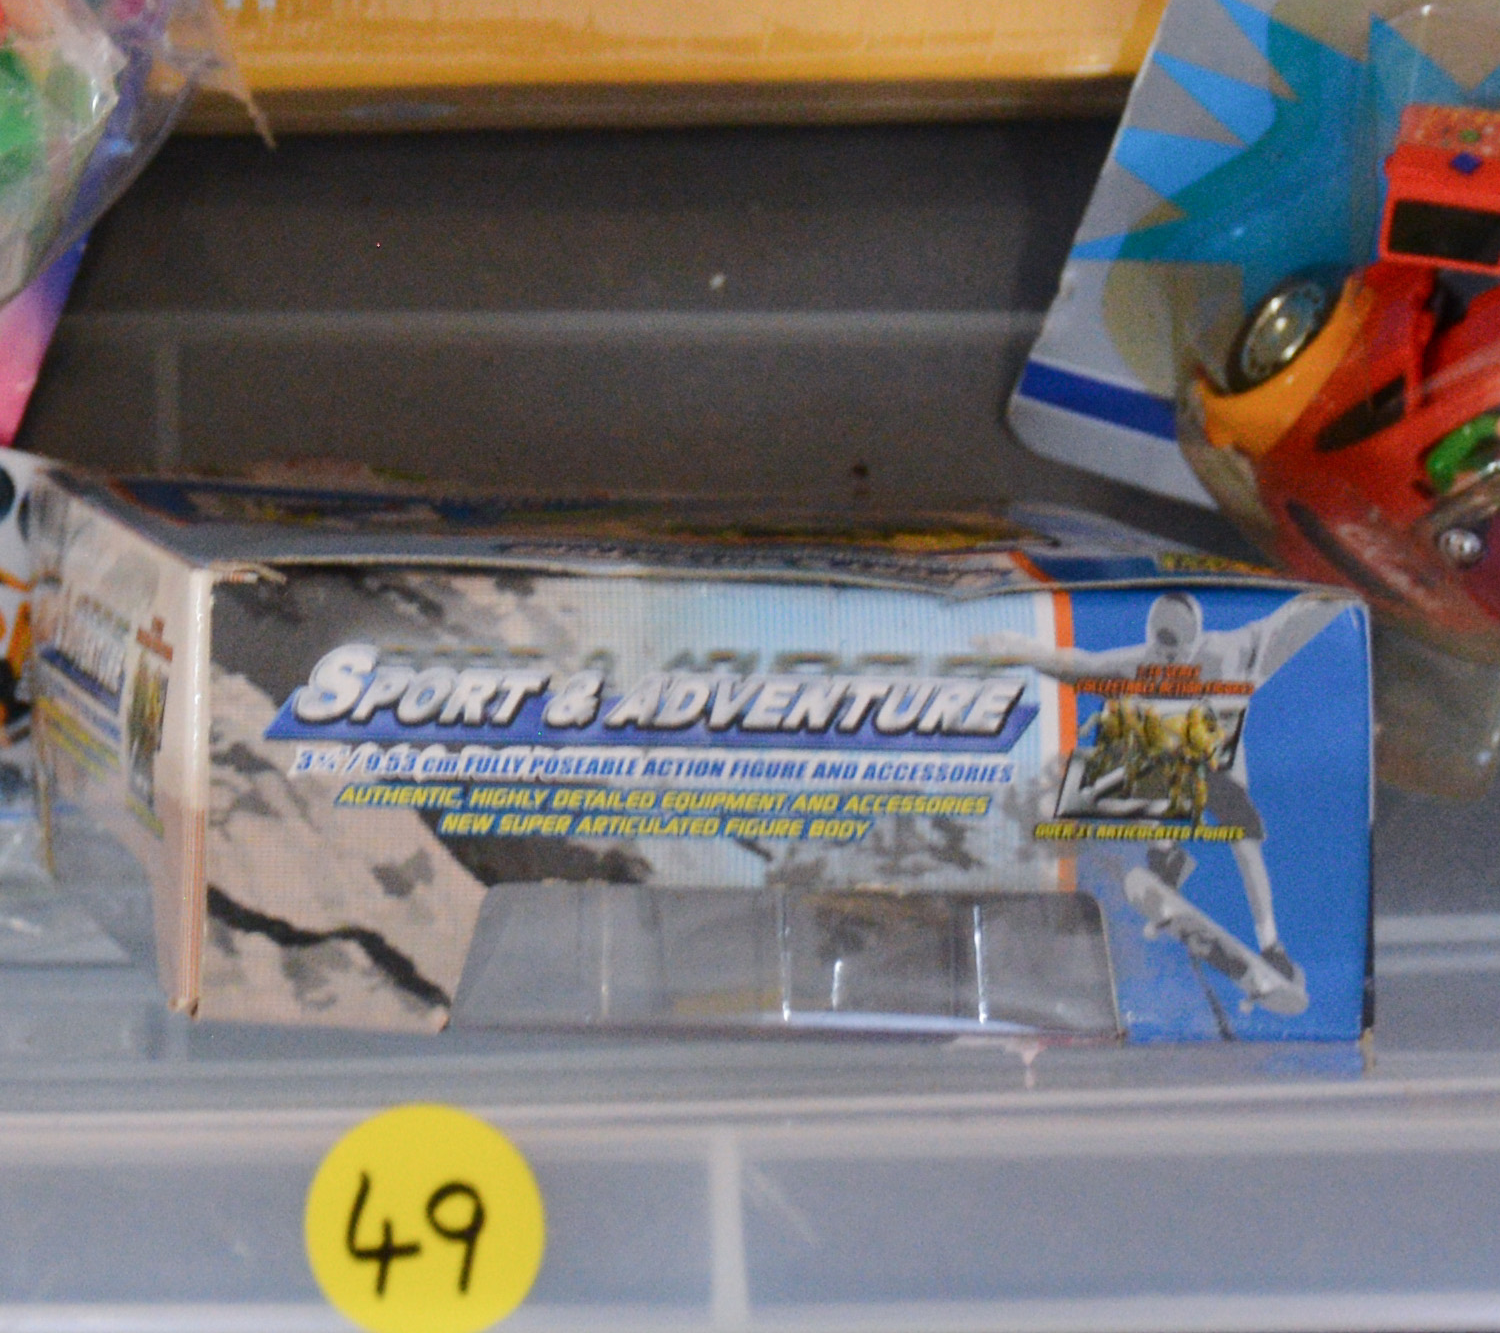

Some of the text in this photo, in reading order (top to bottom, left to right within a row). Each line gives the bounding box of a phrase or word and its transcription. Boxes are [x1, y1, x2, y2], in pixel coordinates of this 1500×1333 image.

[541, 668, 605, 729] &
[604, 670, 1028, 736] ADVENTURE
[420, 753, 460, 774] cm
[463, 753, 524, 775] FULLY
[528, 754, 638, 778] POSEABLE
[642, 757, 726, 779] ACTION
[729, 759, 809, 780] FIGURE
[811, 760, 857, 780] AND
[862, 761, 1016, 783] ACCESSORIES
[469, 786, 549, 808] HIGHLY
[553, 787, 656, 811] DETAILED
[661, 791, 788, 813] EQUIPMENT
[790, 794, 840, 813] AND
[842, 794, 991, 815] ACCESSORIES
[441, 812, 872, 840] NEW SUPER ARTICULATED FIGURE BODY
[346, 1170, 487, 1300] 49
